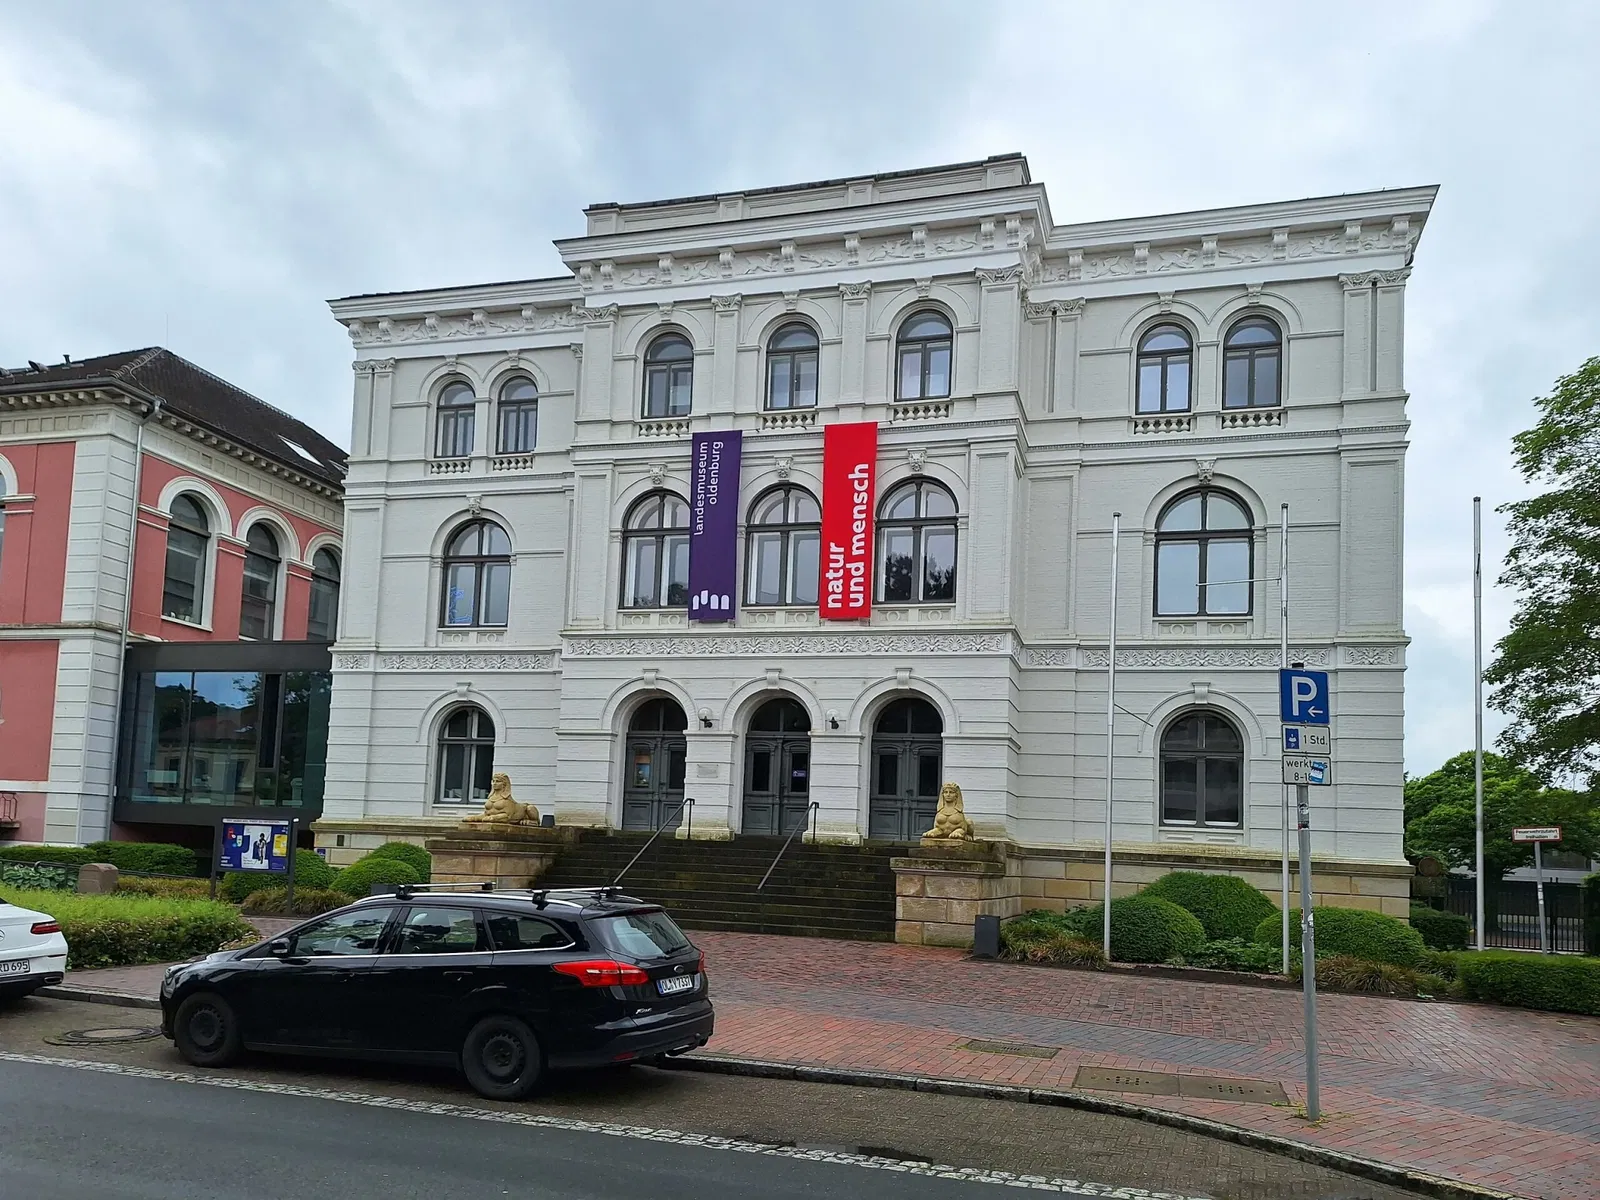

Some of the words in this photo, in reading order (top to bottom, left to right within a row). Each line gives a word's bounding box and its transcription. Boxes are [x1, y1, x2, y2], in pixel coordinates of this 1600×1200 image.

[693, 442, 709, 535] landesmuseum
[706, 441, 724, 505] oldenburg
[848, 463, 869, 556] mensch
[825, 542, 845, 608] natur
[846, 561, 864, 607] und
[1291, 676, 1318, 716] P
[1303, 735, 1307, 744] 1
[1310, 735, 1328, 745] Std.
[11, 961, 28, 971] 695
